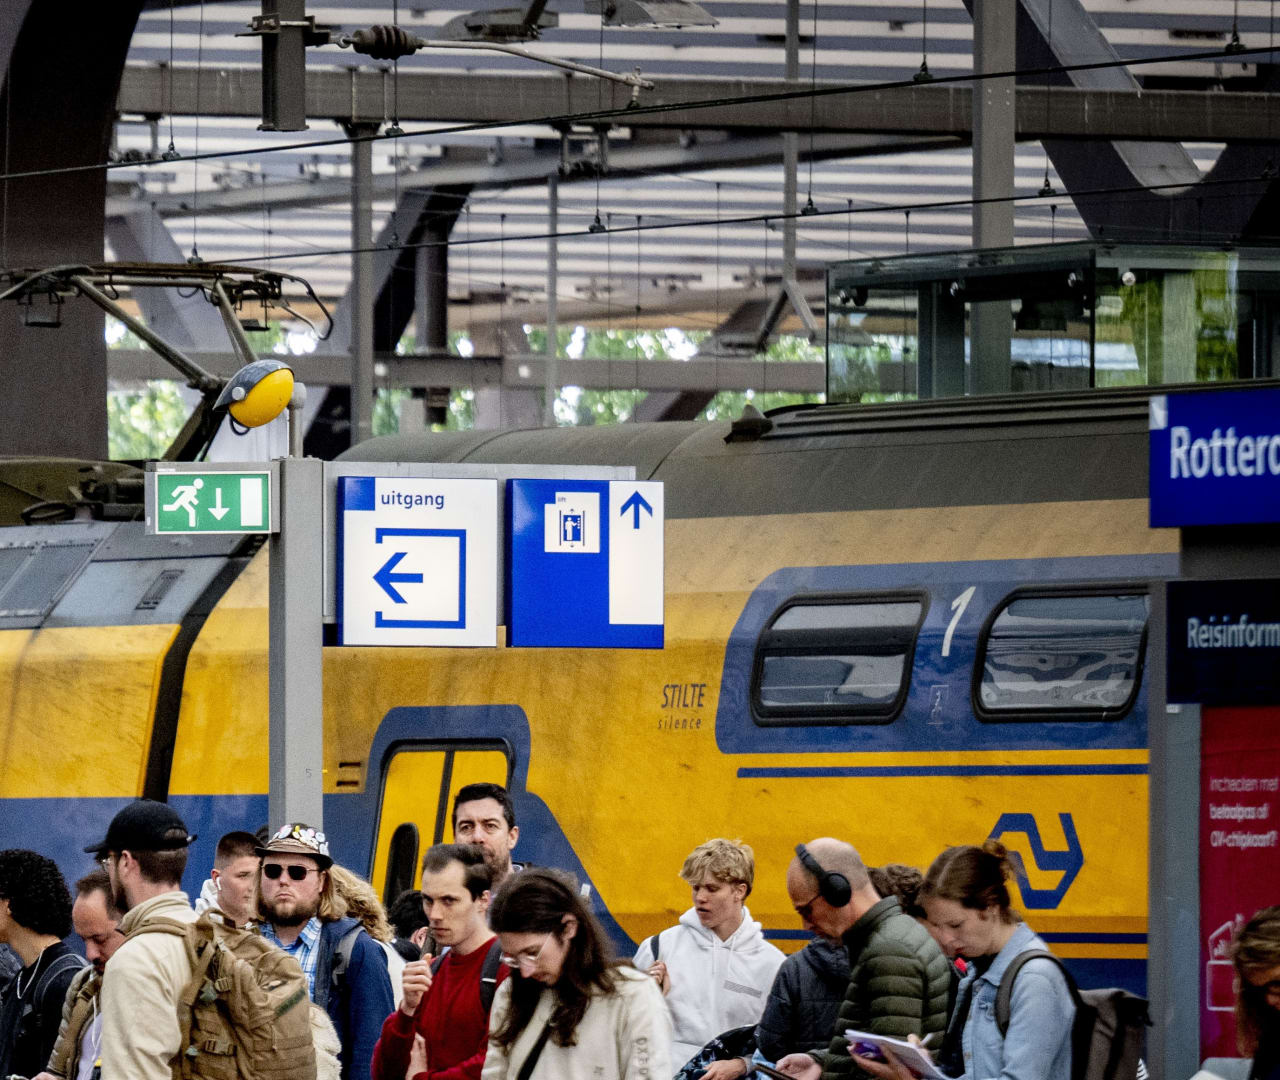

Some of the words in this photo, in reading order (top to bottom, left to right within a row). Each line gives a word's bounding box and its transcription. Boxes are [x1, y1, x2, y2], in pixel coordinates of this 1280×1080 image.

[381, 490, 445, 510] uitgang
[941, 585, 977, 657] 1
[661, 683, 706, 709] STILTE
[657, 715, 702, 729] silence
